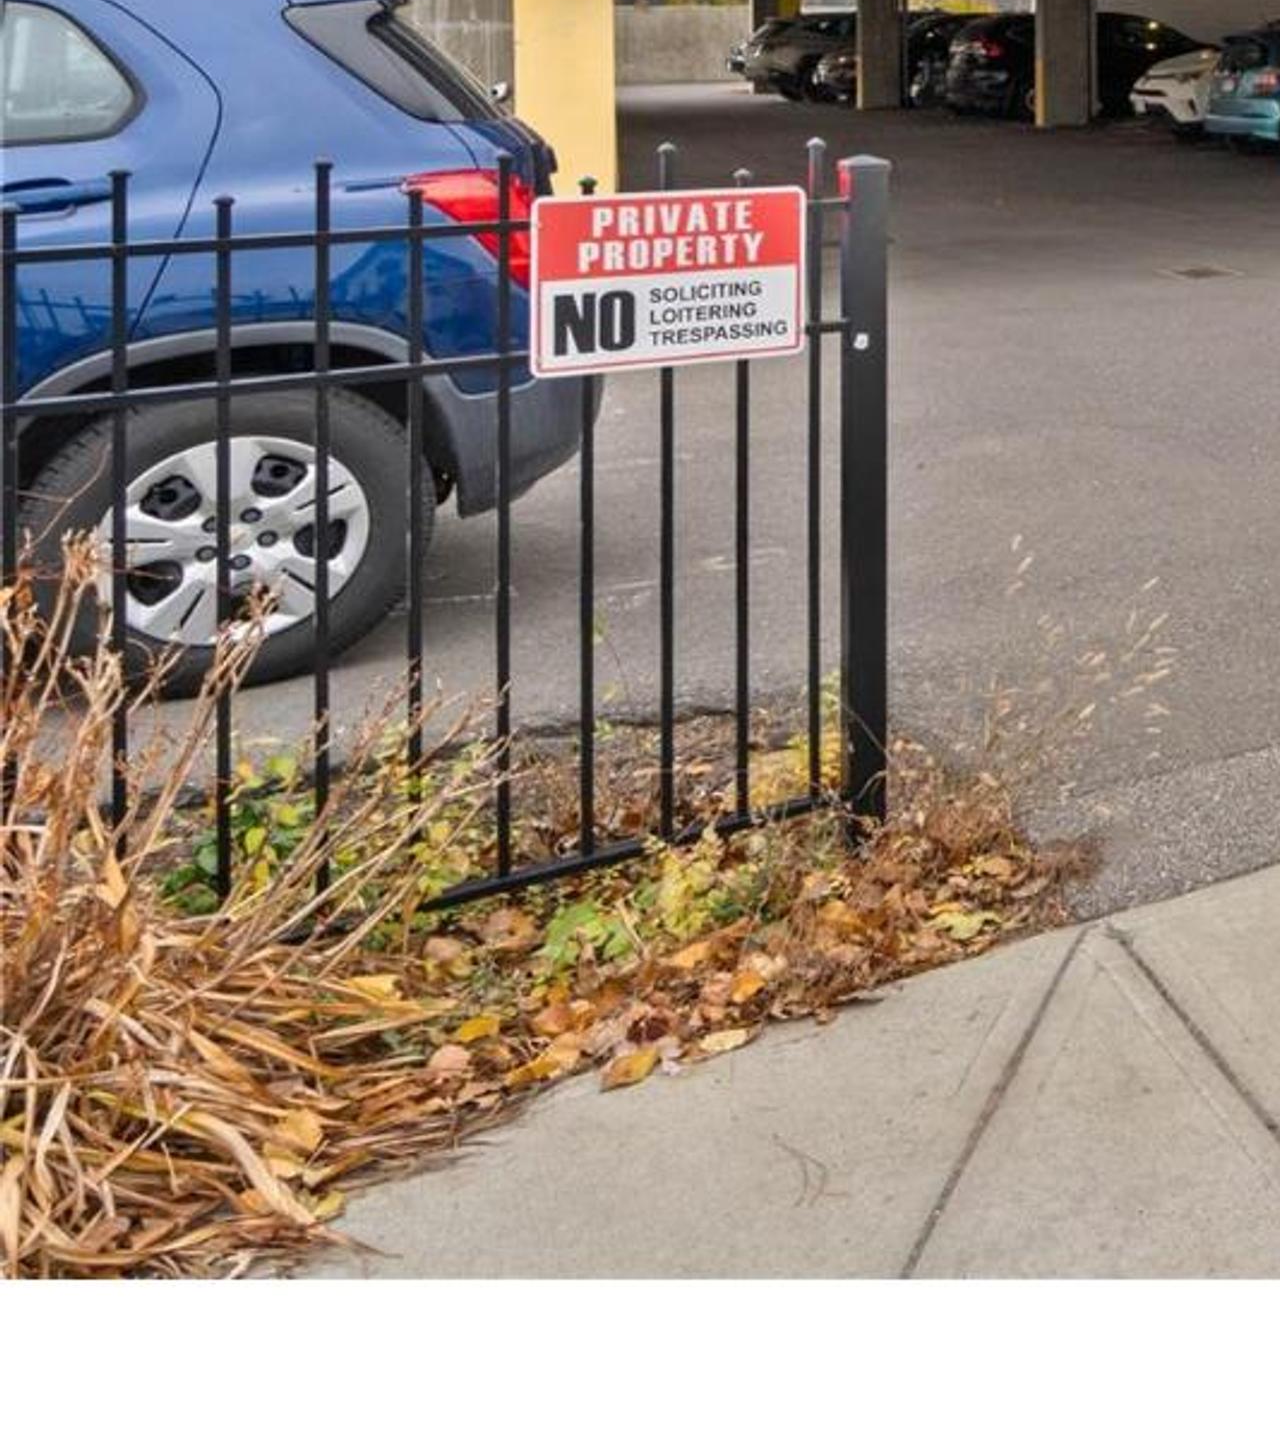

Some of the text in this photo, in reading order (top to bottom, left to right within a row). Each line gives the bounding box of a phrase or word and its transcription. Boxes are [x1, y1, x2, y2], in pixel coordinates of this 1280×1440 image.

[592, 200, 752, 239] PRIVATE
[577, 231, 766, 273] PROPERTY
[649, 280, 763, 304] SOLICITING
[553, 289, 636, 357] NO
[650, 302, 757, 325] LOITERING
[649, 320, 789, 347] TRESPASSING
